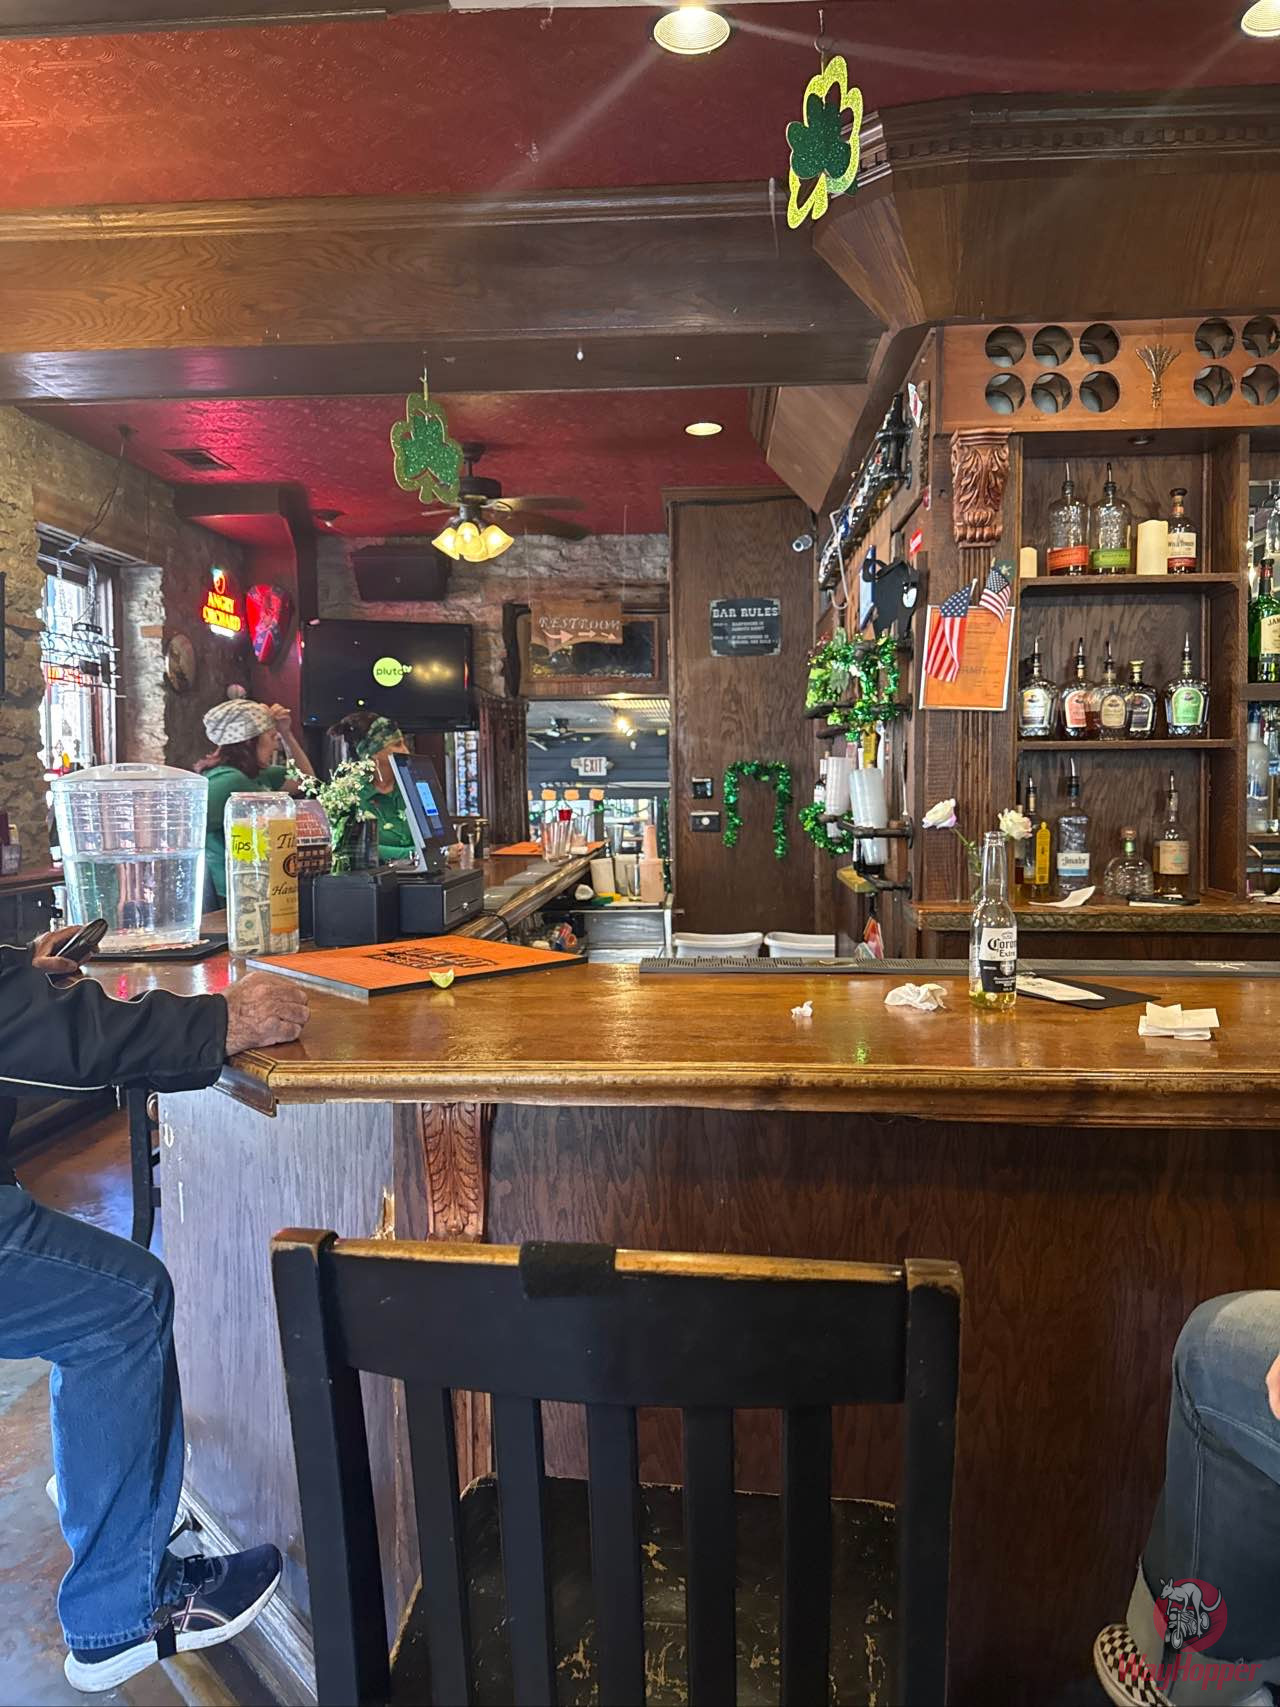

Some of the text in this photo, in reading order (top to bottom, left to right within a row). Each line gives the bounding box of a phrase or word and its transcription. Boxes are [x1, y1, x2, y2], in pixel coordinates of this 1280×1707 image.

[207, 591, 235, 615] ANGRY
[202, 605, 241, 632] ORCHARD
[713, 607, 778, 618] BAR RULES
[539, 616, 620, 630] RESTROOM
[584, 758, 603, 773] EXIT
[232, 834, 251, 853] Tips
